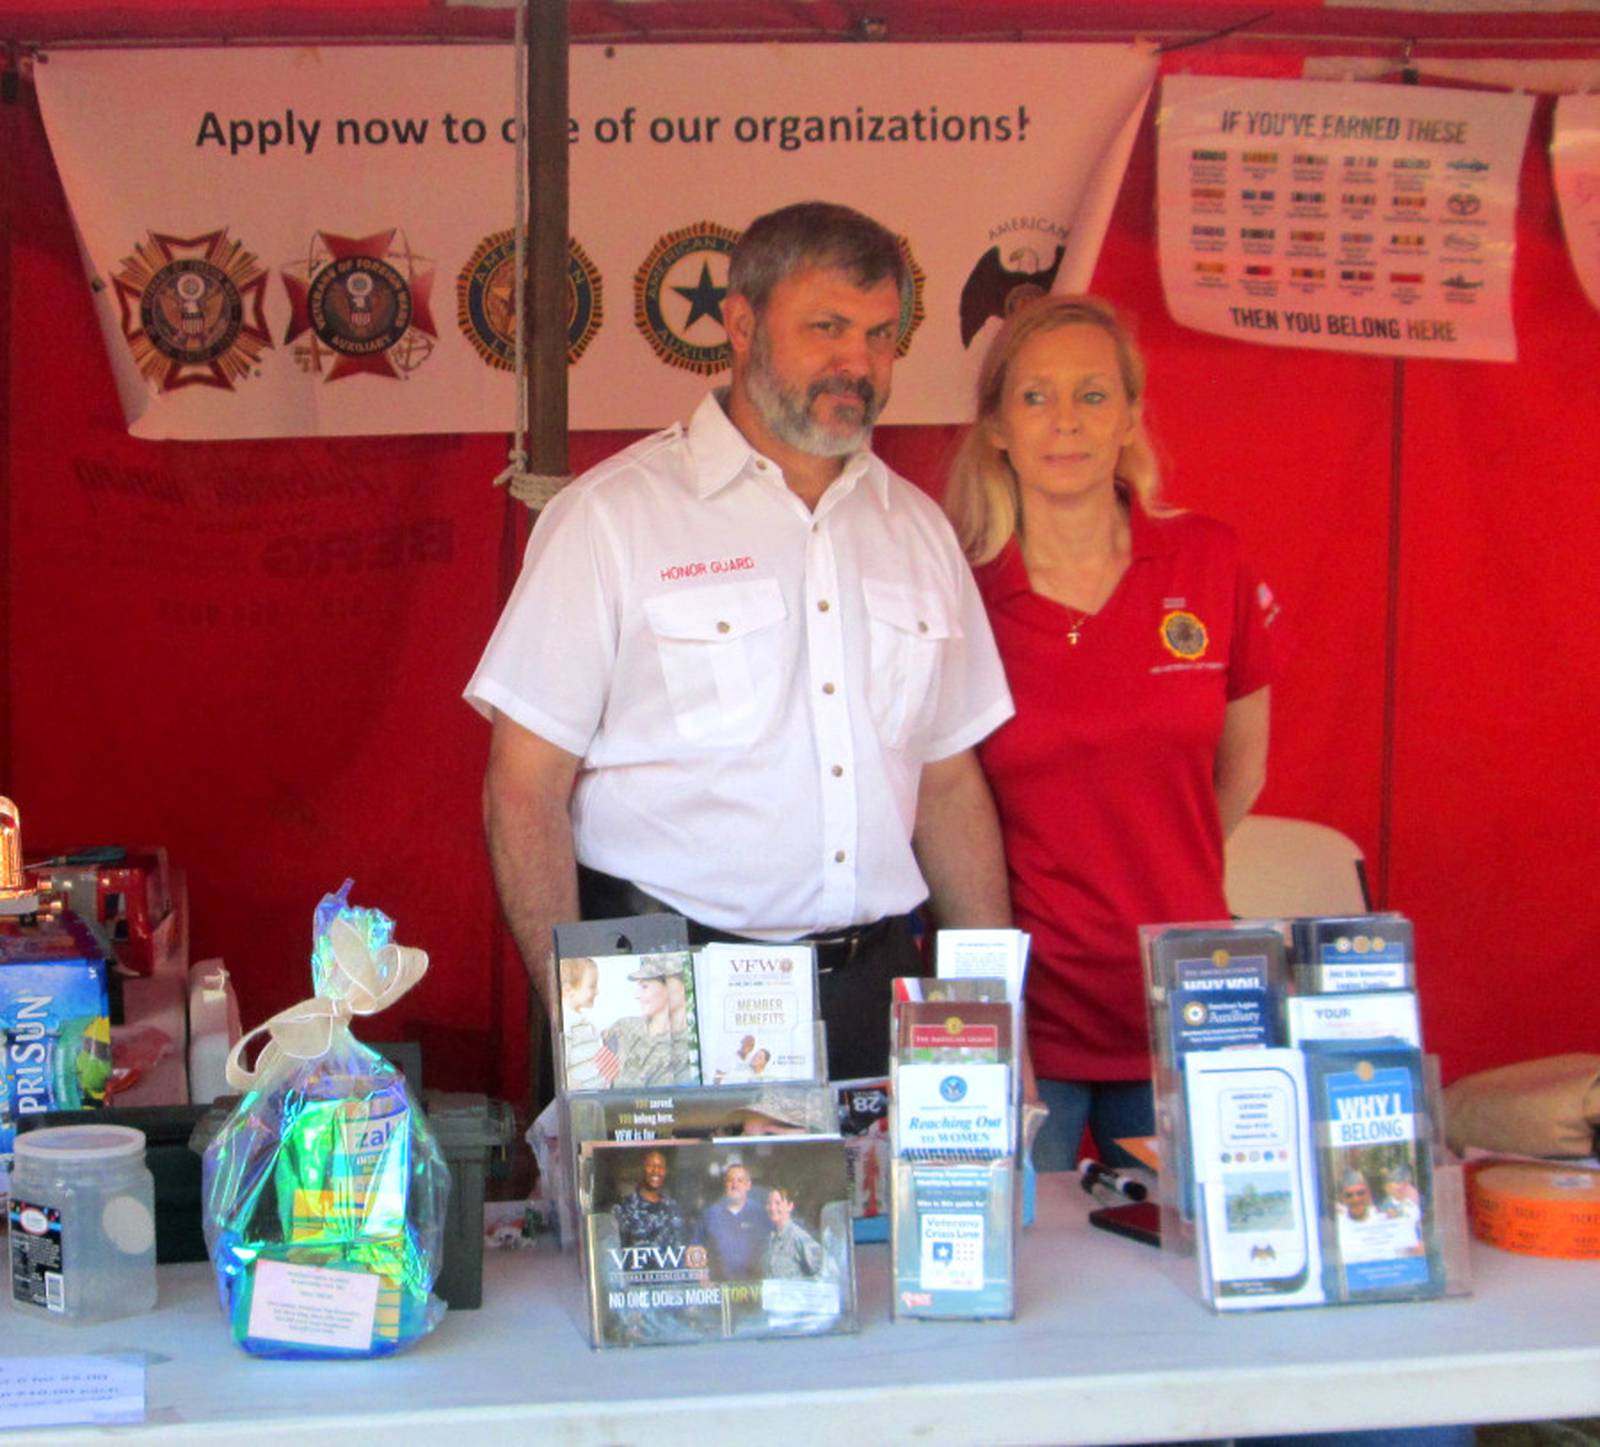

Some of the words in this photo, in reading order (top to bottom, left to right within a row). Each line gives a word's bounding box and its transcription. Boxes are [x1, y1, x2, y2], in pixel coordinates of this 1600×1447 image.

[196, 109, 321, 155] Apply
[336, 119, 429, 145] now
[442, 112, 487, 144] to
[594, 107, 636, 144] of
[650, 116, 720, 144] our
[733, 106, 1029, 151] organizations!
[1221, 111, 1242, 134] IF
[1247, 111, 1316, 137] YOU'VE
[1321, 114, 1400, 141] EARNED
[1406, 118, 1467, 144] THESE
[986, 215, 1070, 241] AMERICAN
[1229, 306, 1279, 331] THEN
[1284, 311, 1321, 334] YOU
[1326, 314, 1400, 341] BELONG
[1406, 318, 1458, 342] HERE
[660, 562, 706, 581] HONOR
[710, 556, 755, 574] GUARD
[728, 959, 778, 973] VFW
[737, 998, 783, 1012] MEMBER
[1315, 1007, 1352, 1020] YOUR
[735, 1012, 786, 1026] BENEFITS
[1336, 1094, 1389, 1120] WHY
[1392, 1093, 1402, 1117] I
[908, 1116, 973, 1131] Reaching
[975, 1115, 1002, 1129] Out
[1341, 1119, 1404, 1142] BELONG
[938, 1132, 991, 1144] WOMEN
[925, 1228, 955, 1240] Crisis
[956, 1228, 981, 1240] Line
[927, 1218, 980, 1229] Veterans
[608, 1245, 685, 1271] VFW
[609, 1291, 625, 1310] NO
[627, 1290, 650, 1309] ONE
[652, 1288, 683, 1308] DOES
[685, 1286, 721, 1306] MORE
